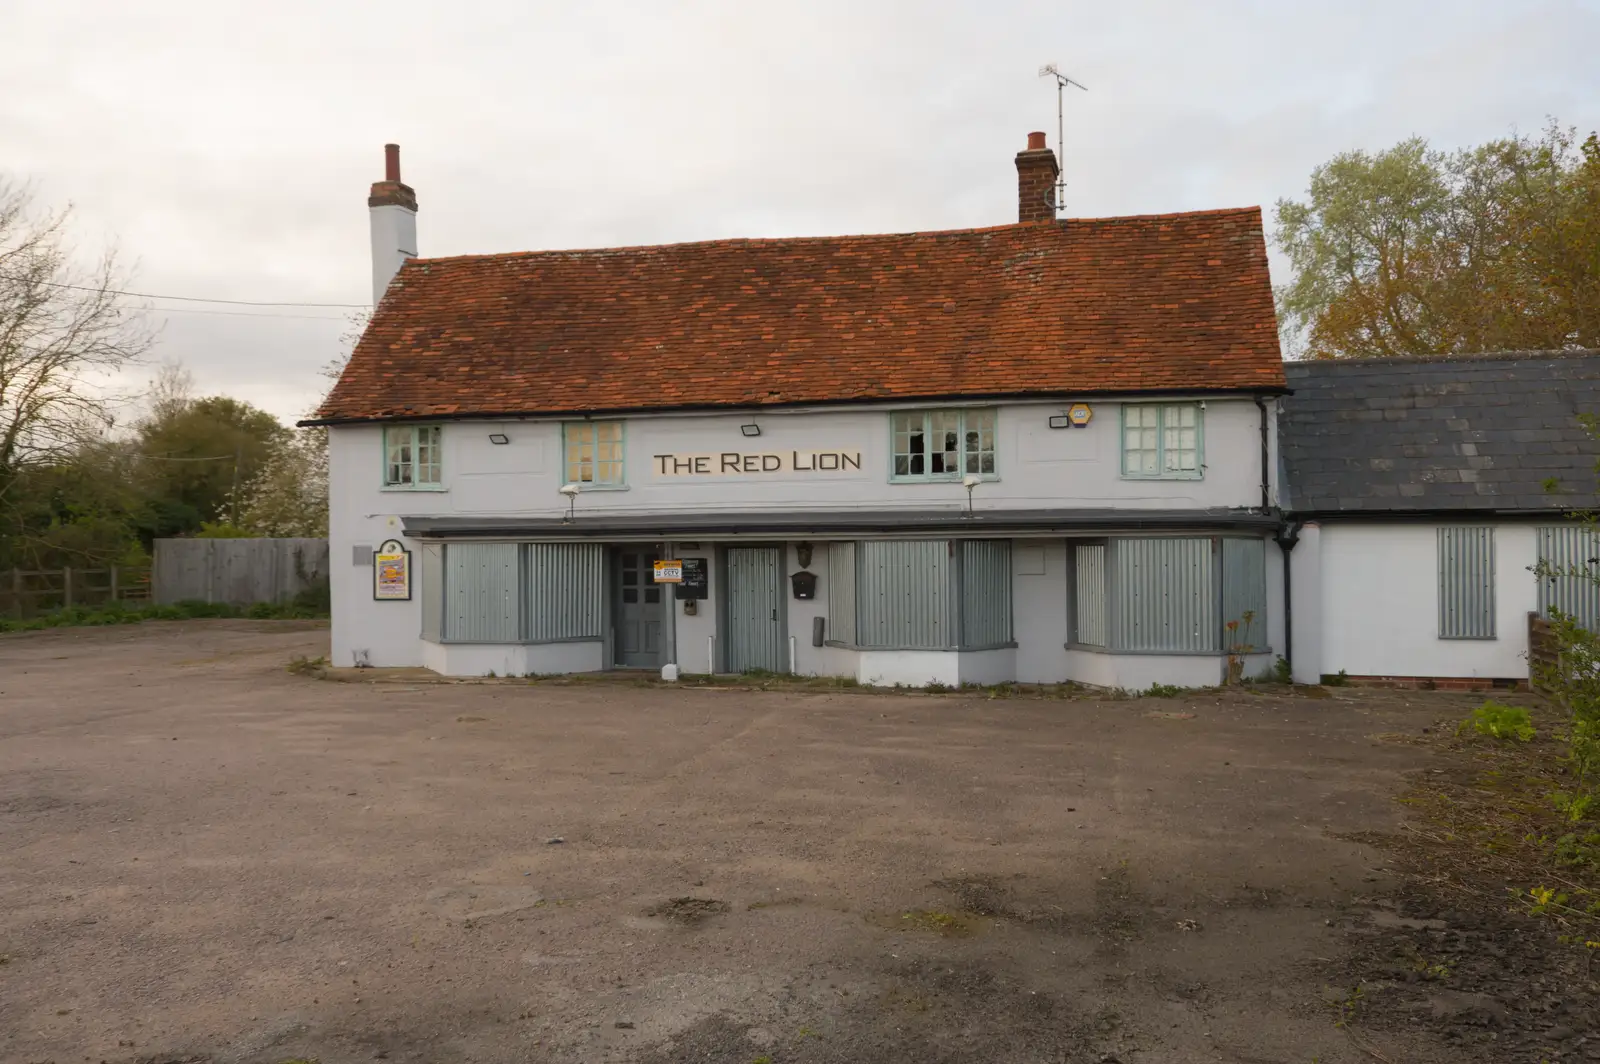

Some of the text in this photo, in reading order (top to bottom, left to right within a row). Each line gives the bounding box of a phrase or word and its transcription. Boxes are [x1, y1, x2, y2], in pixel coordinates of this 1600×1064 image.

[654, 450, 861, 474] THE RED LION
